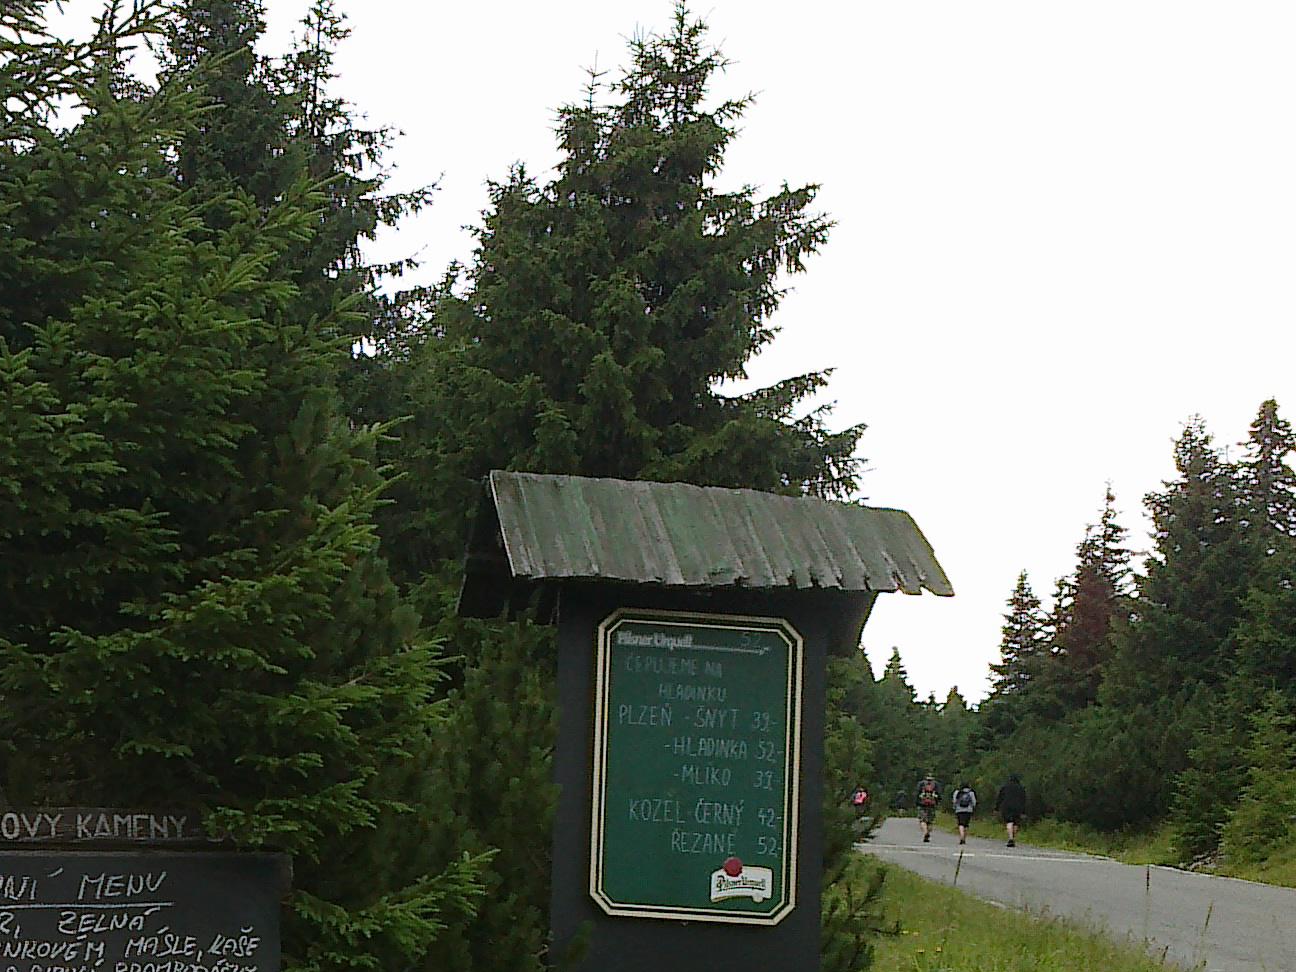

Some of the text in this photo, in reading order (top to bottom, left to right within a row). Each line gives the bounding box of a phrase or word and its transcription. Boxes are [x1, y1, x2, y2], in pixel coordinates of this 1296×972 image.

[76, 812, 188, 840] KAMENY
[78, 871, 167, 900] MENU
[58, 907, 160, 935] ZELNÁ
[207, 926, 261, 957] KAŠE
